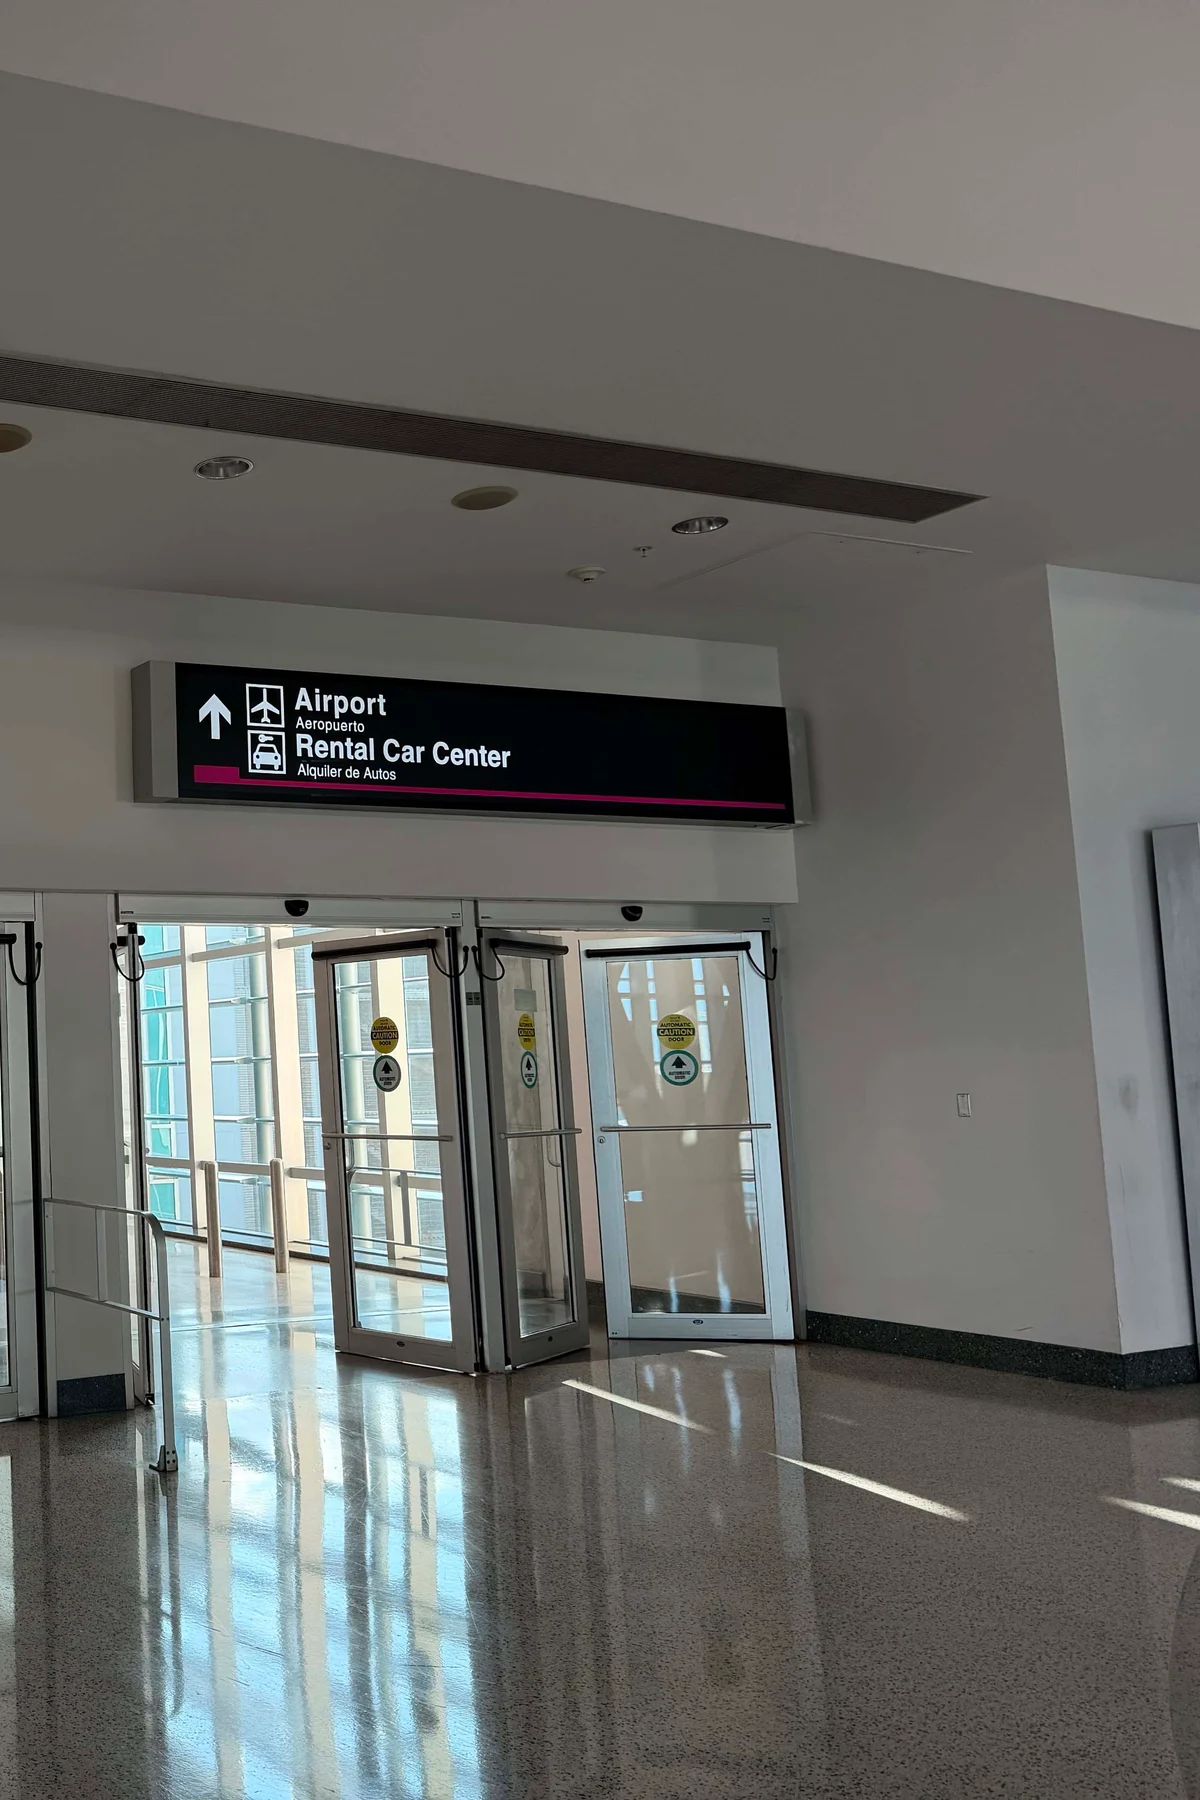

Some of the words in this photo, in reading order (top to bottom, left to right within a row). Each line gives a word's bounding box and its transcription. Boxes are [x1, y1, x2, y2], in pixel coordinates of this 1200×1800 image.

[294, 687, 387, 719] Airport
[295, 716, 365, 733] Aeropuerto
[295, 733, 375, 761] Rental
[382, 738, 426, 764] Car
[432, 741, 511, 768] Center
[297, 763, 342, 780] Alquiler
[345, 765, 360, 779] de
[363, 767, 397, 781] Autos
[372, 1031, 398, 1040] CAUTION
[659, 1028, 693, 1036] CAUTION
